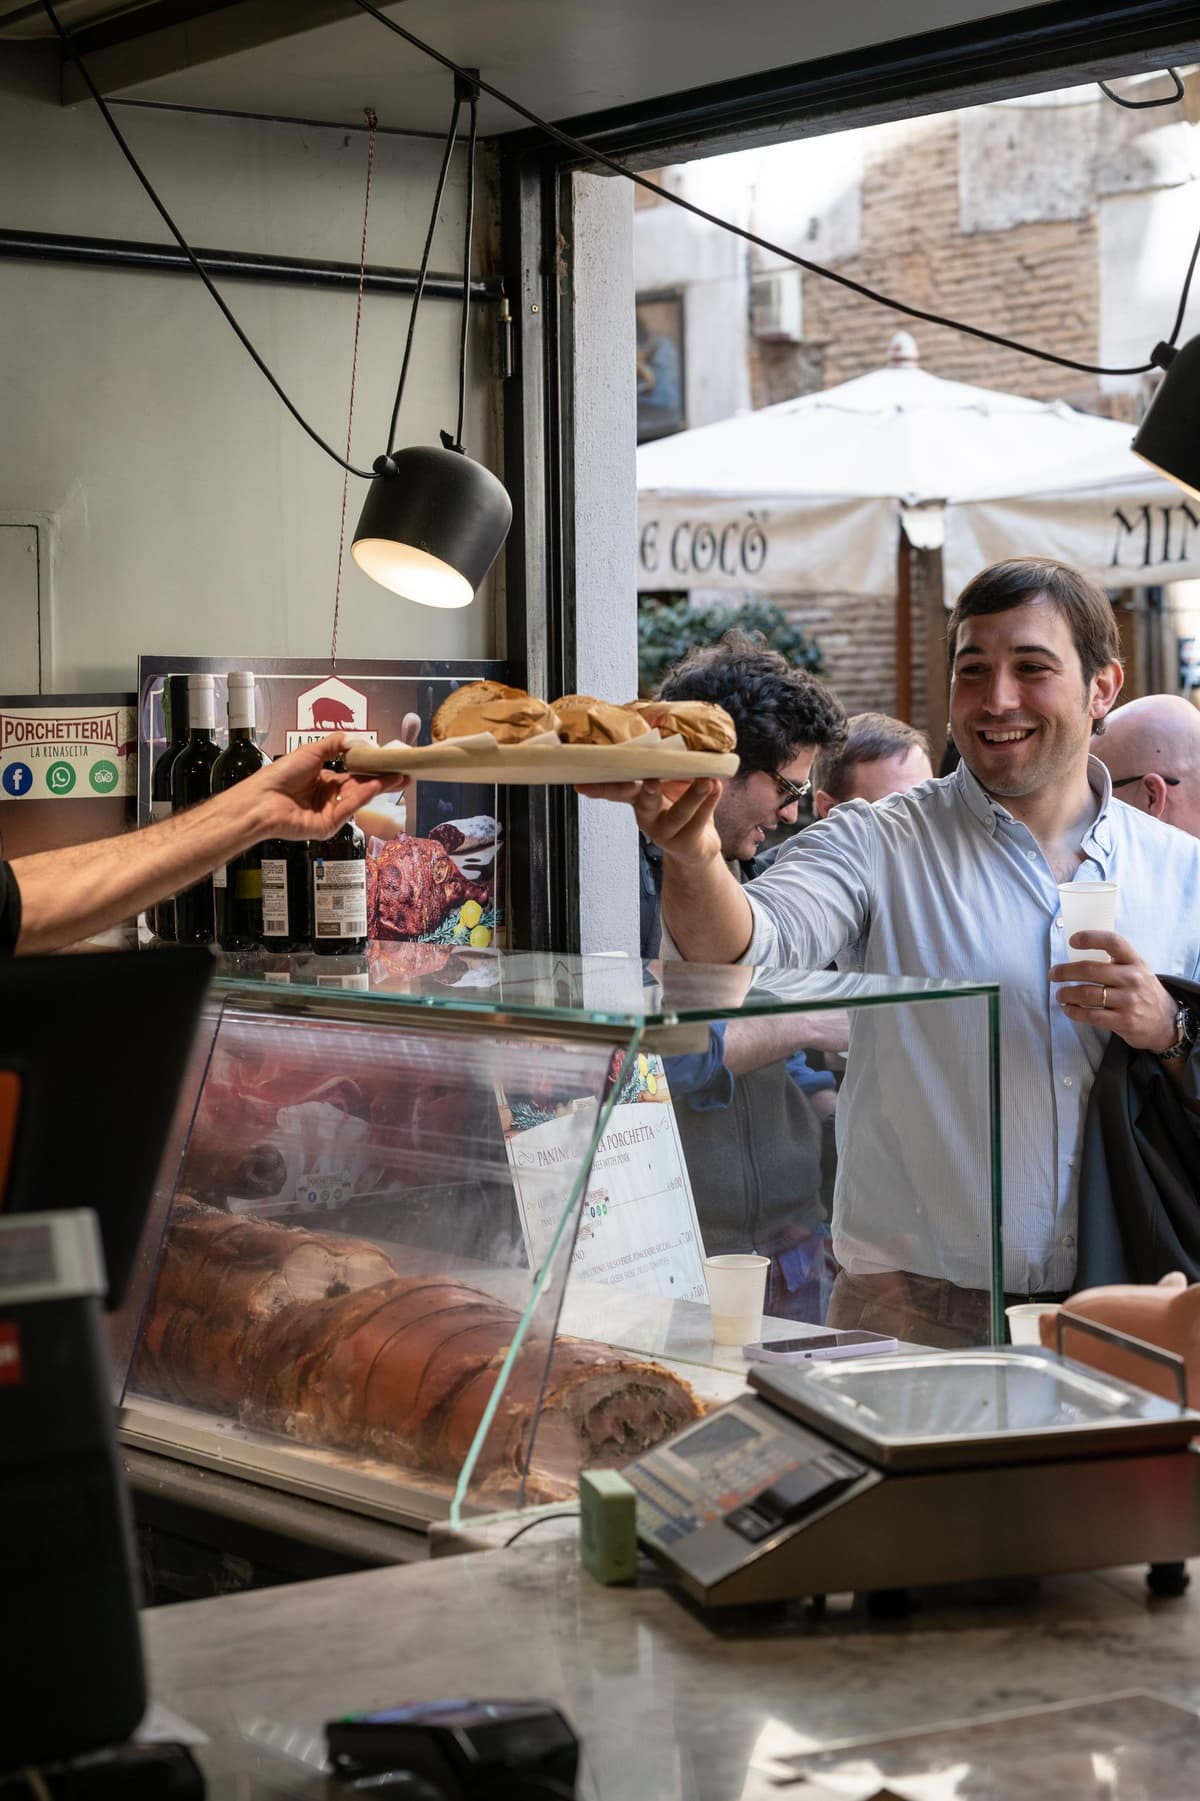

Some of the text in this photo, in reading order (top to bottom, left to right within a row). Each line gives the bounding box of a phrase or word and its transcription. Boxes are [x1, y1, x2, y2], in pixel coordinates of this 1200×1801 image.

[640, 520, 658, 573] E
[4, 719, 114, 744] PORCHETTERIA
[30, 745, 89, 758] LA RINASCITA
[606, 1125, 656, 1151] PORCHETTA
